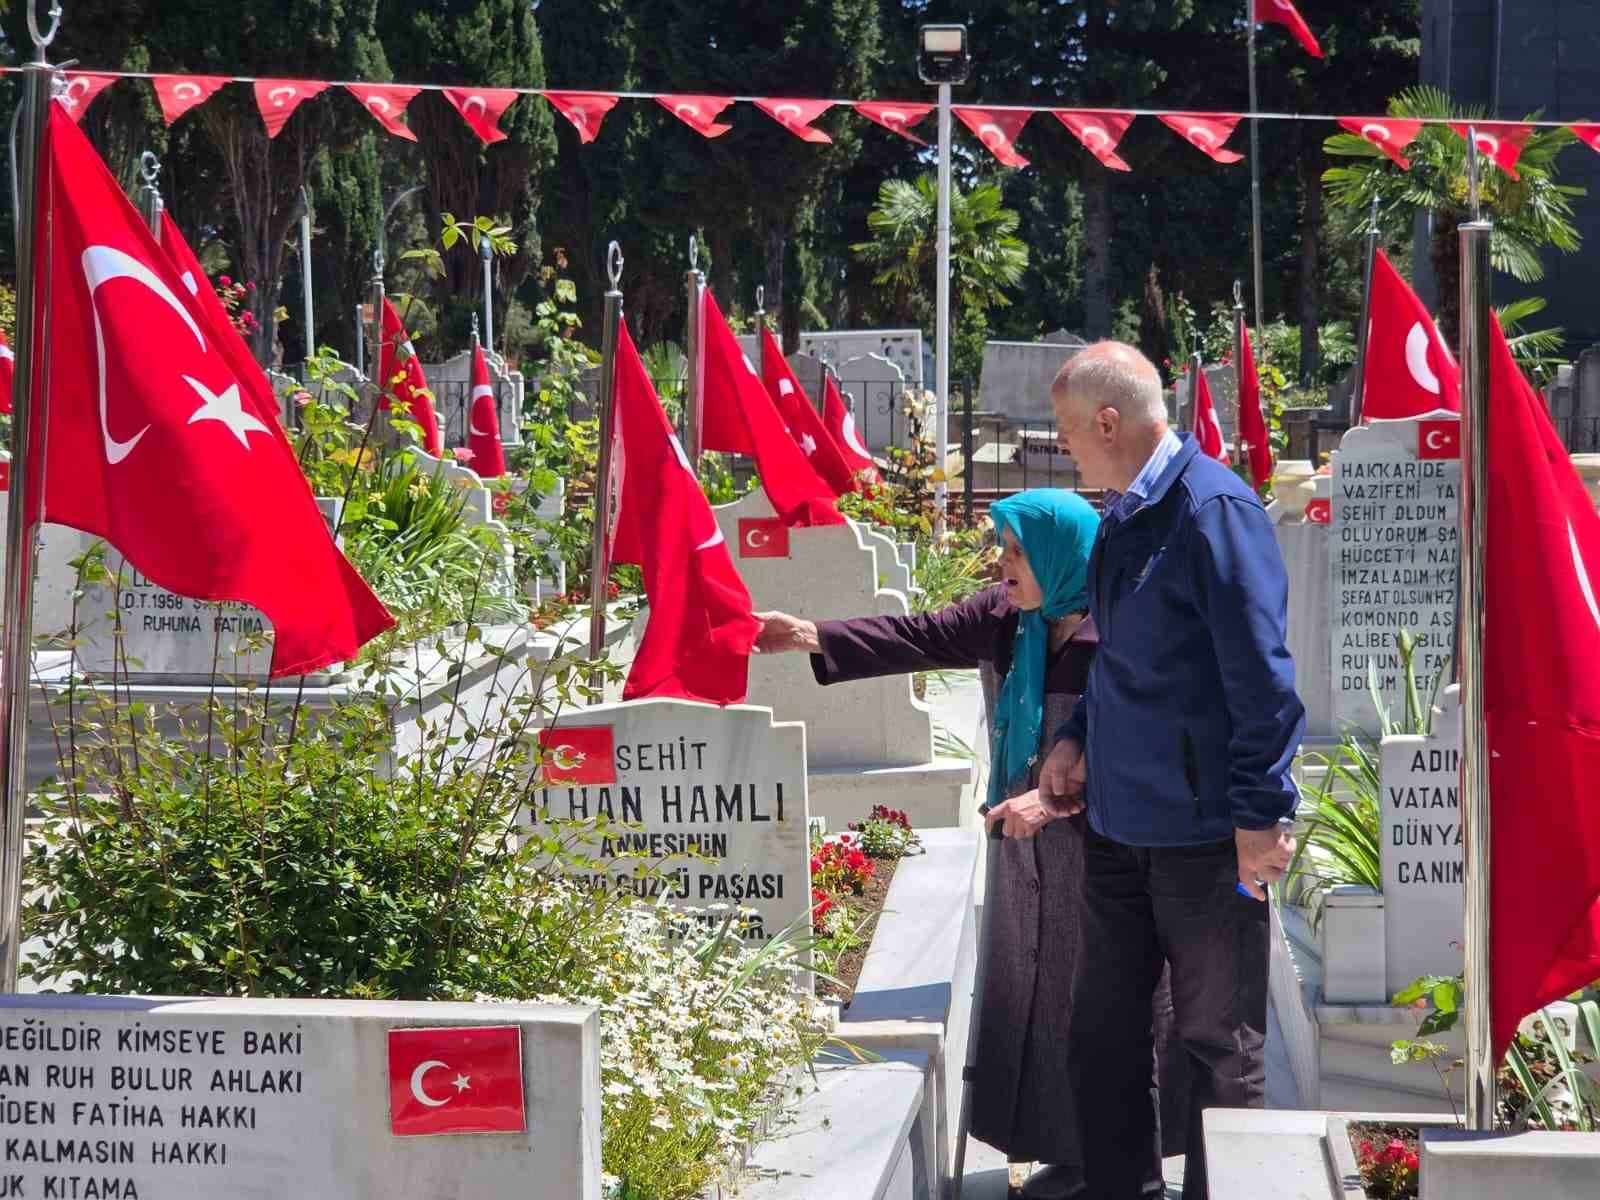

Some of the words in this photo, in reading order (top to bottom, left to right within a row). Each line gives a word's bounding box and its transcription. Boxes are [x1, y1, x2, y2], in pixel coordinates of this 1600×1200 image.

[143, 616, 202, 632] RUHUNA
[1411, 749, 1458, 772] ADI
[661, 783, 784, 824] HAMLI
[699, 873, 784, 905] PAŞASI
[0, 1018, 101, 1051] EĞİLDİR
[117, 1022, 225, 1054] KİMSEYE
[243, 1023, 302, 1055] BAKİ
[46, 1065, 94, 1089] RUH
[111, 1066, 193, 1090] BULUR
[210, 1069, 302, 1093] AHLAKI
[72, 1096, 164, 1127] FATİHA
[181, 1105, 256, 1129] HAKKI
[5, 1138, 134, 1164] KALMASIN
[151, 1141, 227, 1165] HAKKI
[43, 1176, 138, 1200] KITAMA
